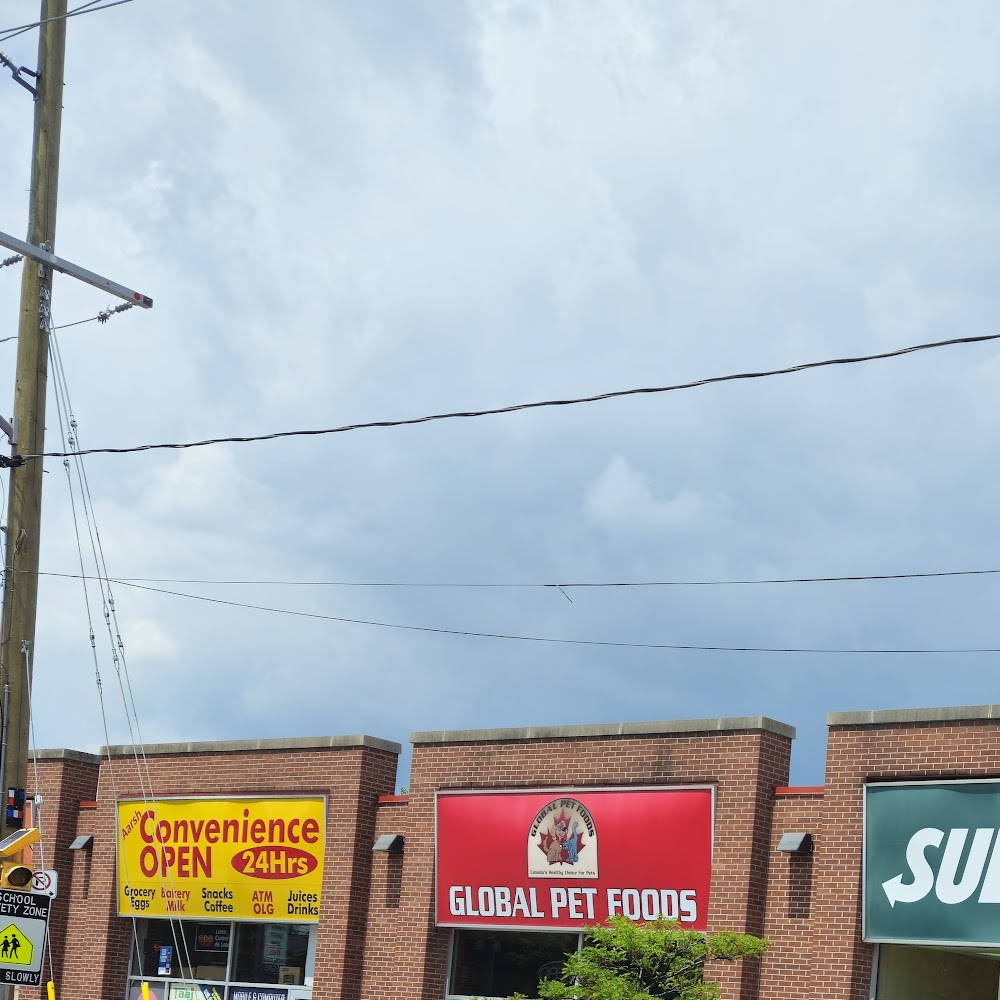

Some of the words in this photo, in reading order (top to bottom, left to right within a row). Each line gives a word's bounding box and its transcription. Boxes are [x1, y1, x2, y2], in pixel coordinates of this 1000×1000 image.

[121, 810, 143, 840] Aarsh
[531, 803, 557, 837] GLOBAL
[561, 800, 576, 810] PET
[576, 805, 595, 837] FOODS
[140, 808, 320, 844] Convenience
[140, 845, 212, 878] OPEN
[242, 850, 308, 874] 24Hrs
[124, 886, 156, 900] Grocery
[161, 888, 190, 901] Bakery
[202, 888, 233, 900] Snacks
[252, 890, 273, 902] ATM
[288, 890, 318, 902] Juices
[130, 898, 150, 910] Eggs
[166, 900, 185, 912] Milk
[204, 900, 234, 913] Coffee
[253, 903, 274, 915] OLG
[287, 903, 319, 915] Drinks
[449, 885, 544, 918] GLOBAL
[550, 887, 598, 920] PET
[606, 888, 697, 922] FOODS
[0, 904, 19, 914] ETY
[23, 906, 48, 917] ZONE
[5, 971, 40, 983] SLOWLY
